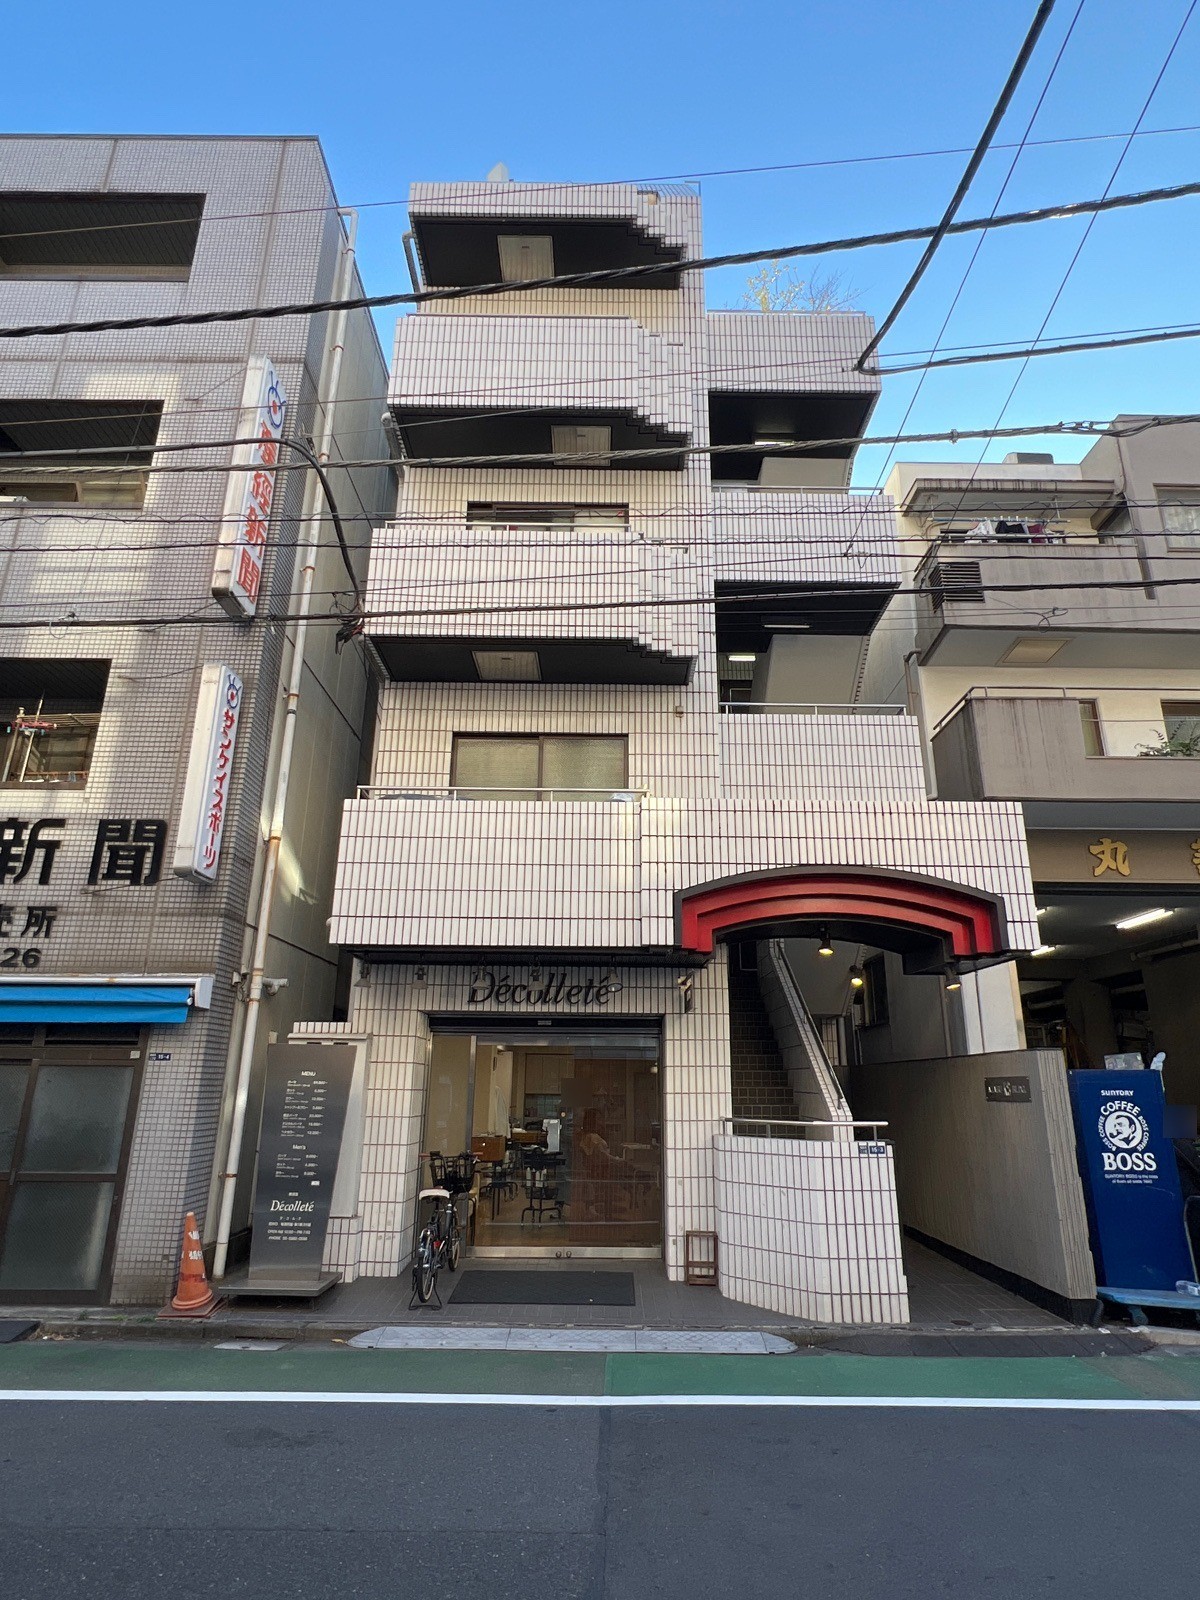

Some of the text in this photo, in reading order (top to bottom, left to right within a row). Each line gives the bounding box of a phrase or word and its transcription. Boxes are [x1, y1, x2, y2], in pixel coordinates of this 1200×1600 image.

[203, 708, 236, 870] サンケイスポーツ
[0, 817, 168, 886] 新聞
[0, 947, 42, 968] 26
[1101, 1101, 1140, 1116] COFFEE
[1136, 1116, 1149, 1151] BOSS COFFEE
[1101, 1152, 1157, 1171] BOSS
[270, 1199, 315, 1212] Décolleté
